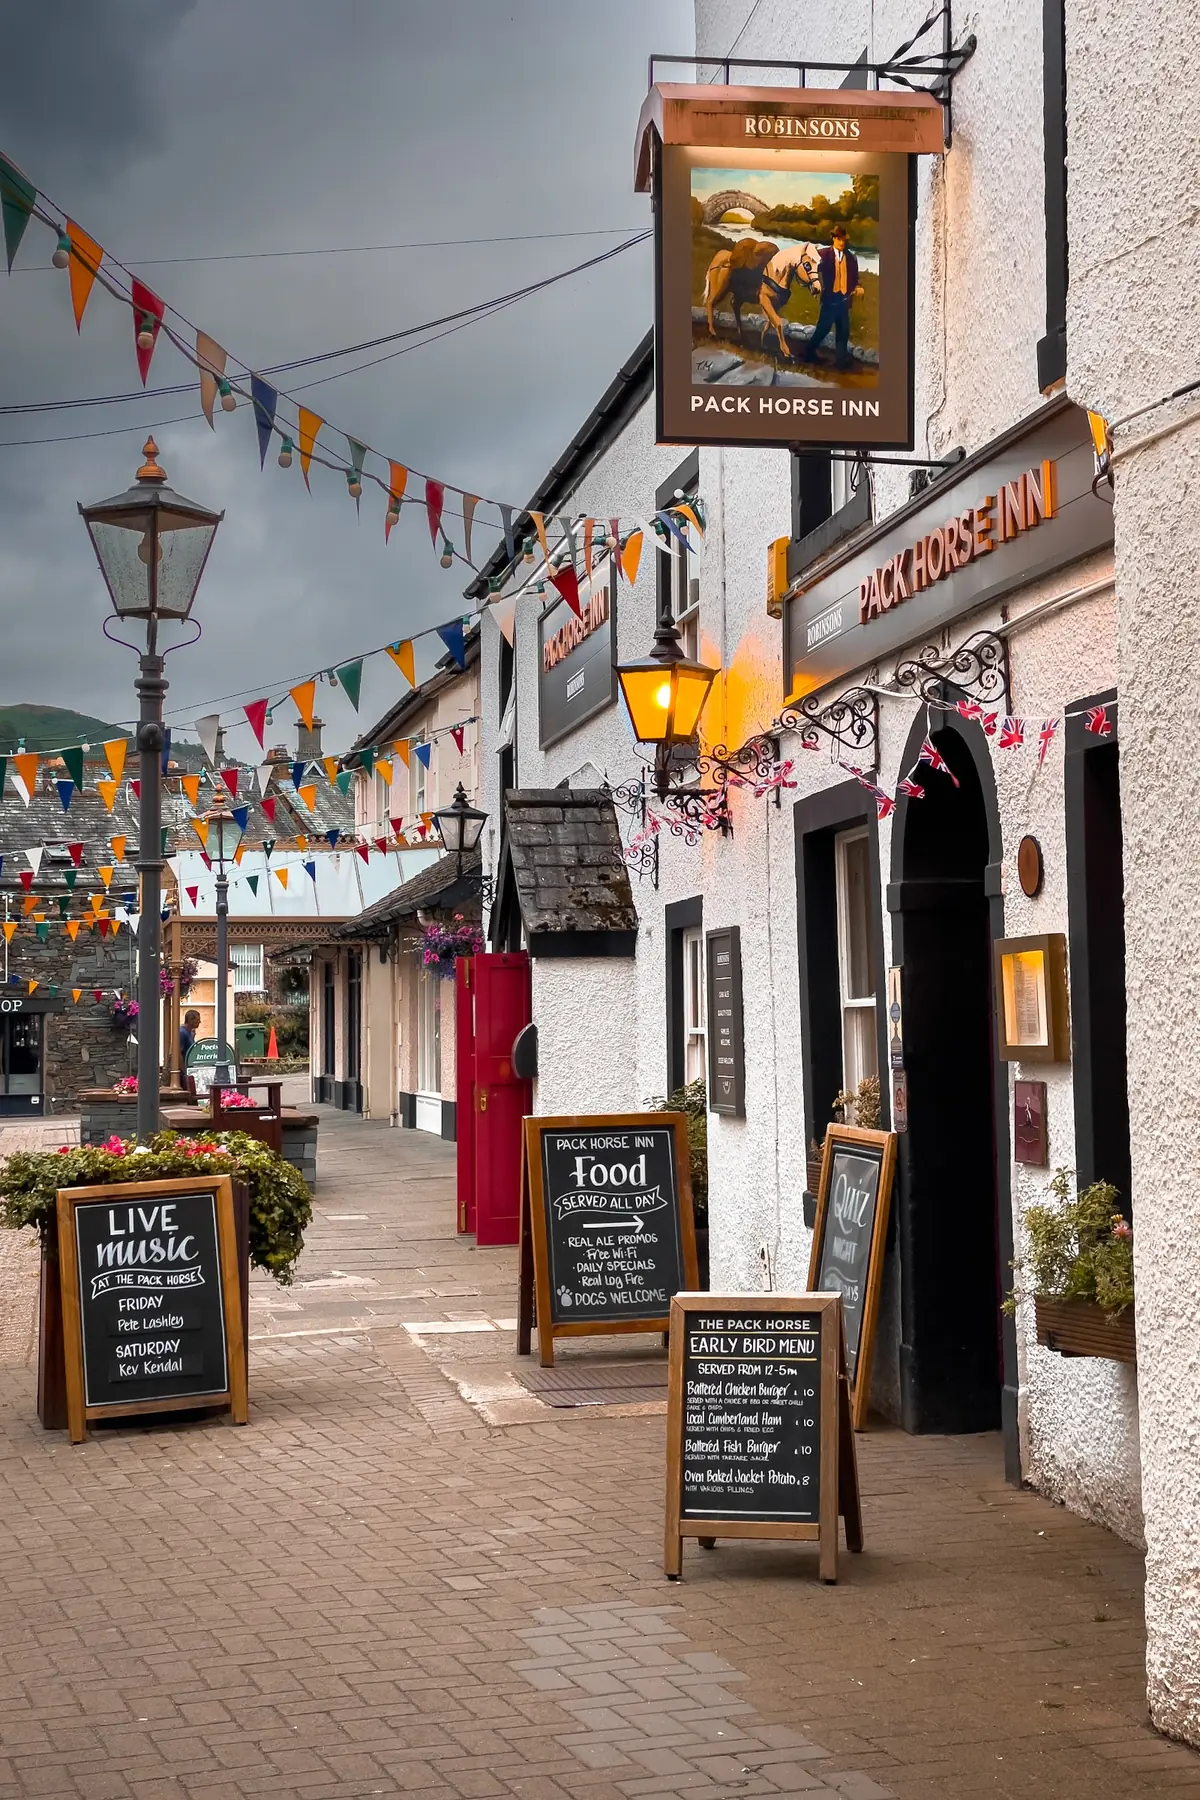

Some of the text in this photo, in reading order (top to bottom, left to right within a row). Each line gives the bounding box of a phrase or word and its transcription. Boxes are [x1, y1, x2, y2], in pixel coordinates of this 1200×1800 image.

[745, 118, 860, 137] ROBINSONS
[690, 395, 880, 417] PACK HORSE INN
[859, 460, 1055, 624] PACK HORSE INN
[807, 608, 842, 647] ROBINSONS
[556, 1136, 654, 1151] PACK HORSE INN
[568, 1154, 648, 1187] Food
[562, 1192, 655, 1211] SERVED ALL DAY
[109, 1204, 179, 1236] LIVE
[97, 1231, 199, 1268] music
[568, 1233, 659, 1248] REAL ALE PROMOS
[586, 1248, 611, 1260] Free
[576, 1259, 656, 1273] DAILY SPECIALS
[98, 1271, 198, 1290] AT THE PACK HORSE
[581, 1272, 645, 1289] Real Log Fire
[118, 1294, 164, 1312] FRIDAY
[575, 1288, 667, 1306] DOGS WELCOME
[117, 1313, 184, 1332] Pete Lashley
[698, 1319, 811, 1330] THE PACK HORSE
[115, 1338, 181, 1358] SATURDAY
[690, 1337, 815, 1354] EARLY BIRD MENU
[119, 1357, 183, 1377] Kev Kendal
[697, 1363, 735, 1375] SERVED
[737, 1363, 762, 1375] FROM
[687, 1380, 722, 1396] Battered
[724, 1382, 757, 1396] Chicken
[758, 1382, 791, 1400] Burger
[803, 1388, 815, 1397] 10
[686, 1411, 705, 1425] Local
[708, 1412, 759, 1425] Cumberland
[761, 1411, 782, 1426] Ham
[803, 1419, 814, 1427] 10
[684, 1439, 720, 1453] Battered
[723, 1440, 742, 1453] Fish
[746, 1439, 781, 1459] Burger
[801, 1446, 812, 1455] 10
[706, 1468, 733, 1483] Baked
[734, 1469, 765, 1484] Jacket
[768, 1469, 796, 1485] Potato
[802, 1475, 810, 1486] 8
